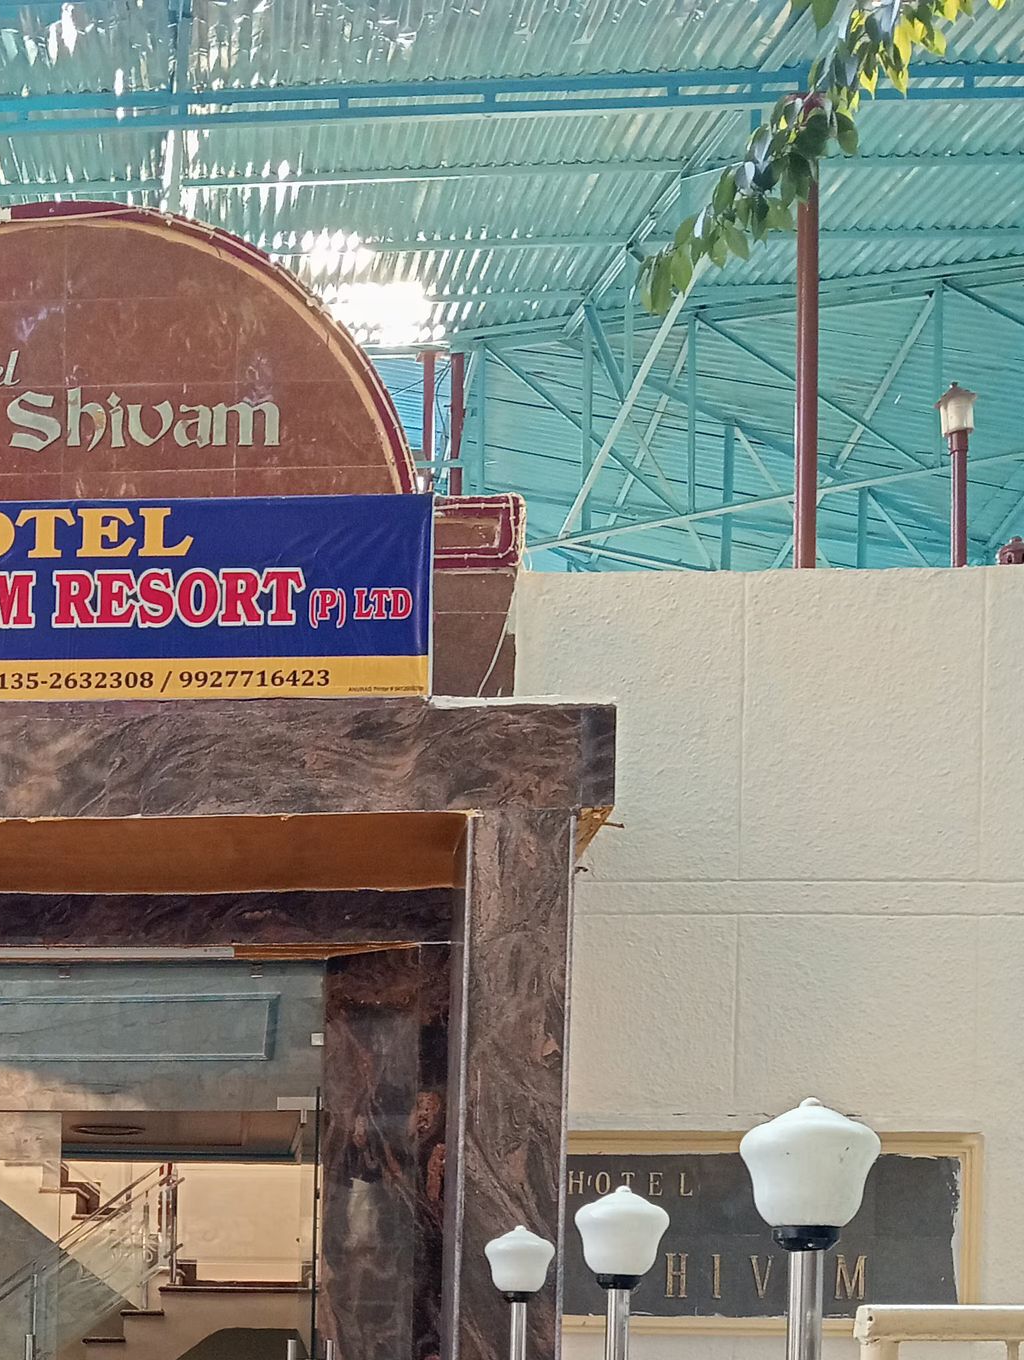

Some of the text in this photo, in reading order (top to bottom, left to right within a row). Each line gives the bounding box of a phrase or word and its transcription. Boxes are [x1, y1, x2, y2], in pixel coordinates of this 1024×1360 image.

[6, 386, 280, 453] Shivam
[52, 566, 307, 629] RESORT
[308, 587, 347, 629] (P)
[353, 586, 414, 621] LTD
[178, 669, 330, 689] 9927716423
[567, 1170, 693, 1197] HOTEL
[632, 1252, 868, 1300] HIVM
